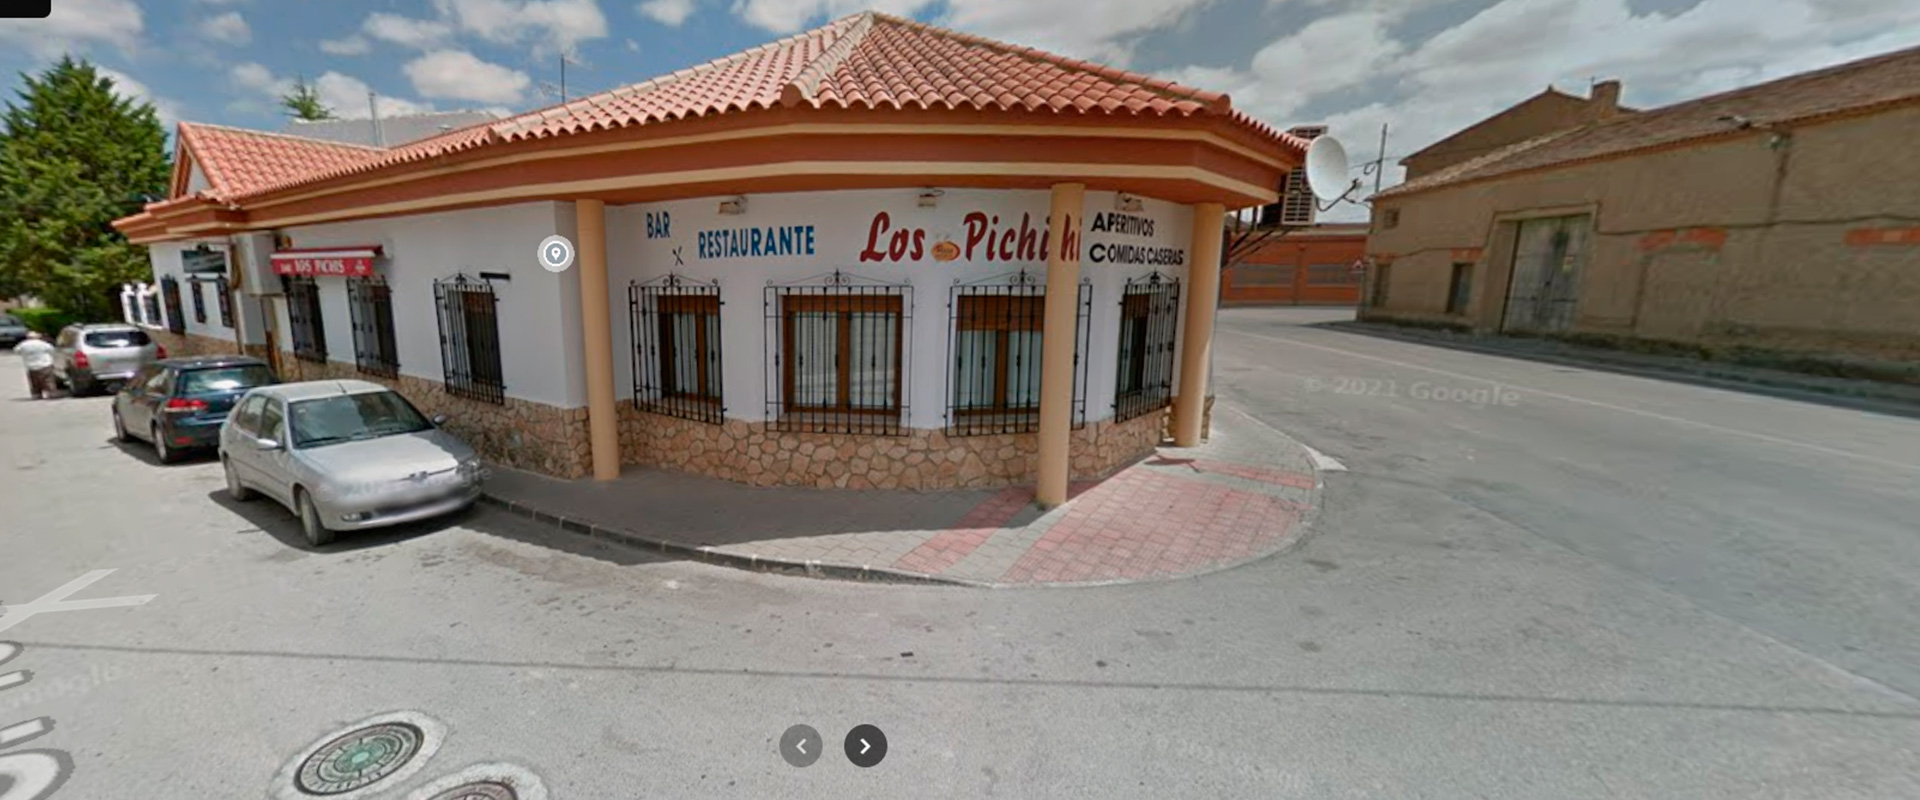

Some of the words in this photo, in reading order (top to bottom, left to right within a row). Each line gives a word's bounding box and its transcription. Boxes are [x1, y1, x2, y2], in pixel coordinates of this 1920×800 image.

[646, 211, 671, 239] BAR
[859, 211, 926, 262] Los
[1090, 211, 1155, 237] APERITIVOS
[698, 225, 816, 259] RESTAURANTE
[1089, 243, 1146, 264] COMIDAS
[1146, 246, 1184, 266] CASERAS
